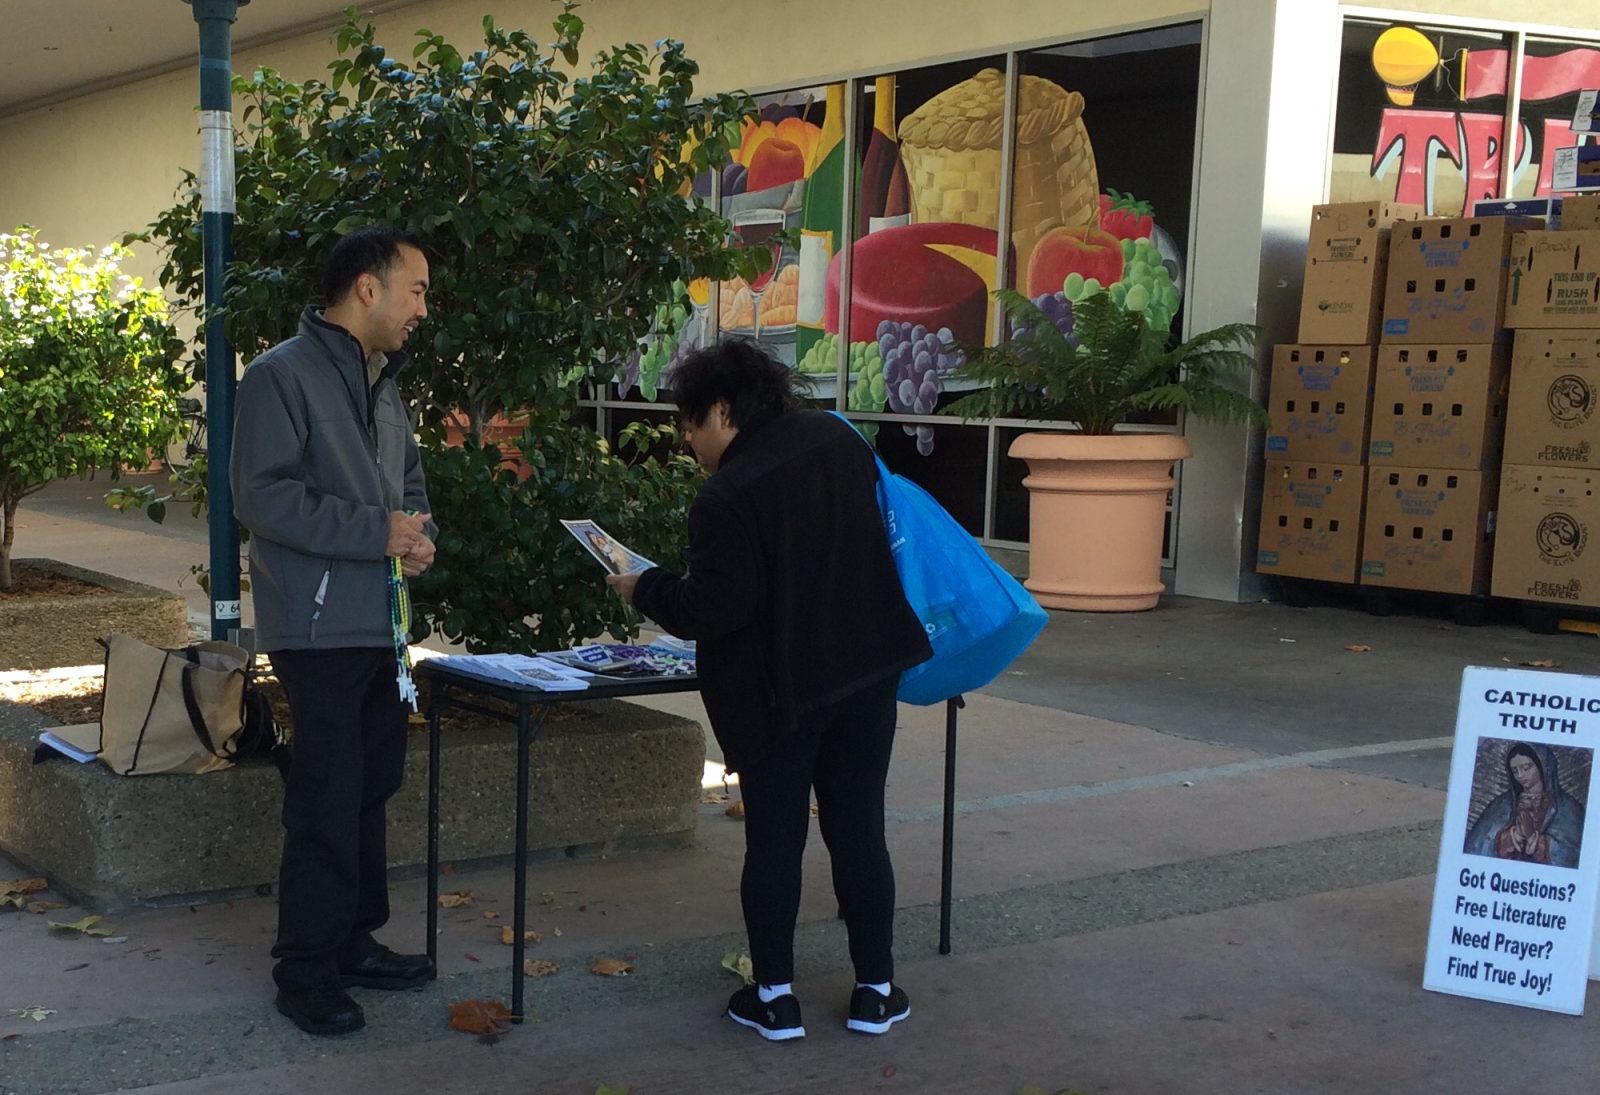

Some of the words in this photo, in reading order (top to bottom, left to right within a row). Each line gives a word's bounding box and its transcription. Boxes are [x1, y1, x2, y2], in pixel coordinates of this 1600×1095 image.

[1586, 271, 1597, 282] UP
[1557, 288, 1589, 298] RUSH
[1537, 451, 1589, 463] FLOWERS
[1545, 444, 1581, 455] FRESH
[1527, 587, 1579, 600] FLOWERS
[1534, 581, 1570, 592] FRESH
[1484, 689, 1600, 714] CATHOLIC
[1499, 712, 1577, 734] TRUTH
[1459, 868, 1486, 890] Got
[1490, 872, 1577, 902] Questions?
[1455, 896, 1488, 918] Free
[1492, 901, 1566, 931] Literature
[1451, 926, 1491, 950] Need
[1494, 932, 1553, 961] Prayer?
[1447, 956, 1479, 980] Find
[1484, 962, 1516, 985] True
[1520, 969, 1553, 996] Joy!
